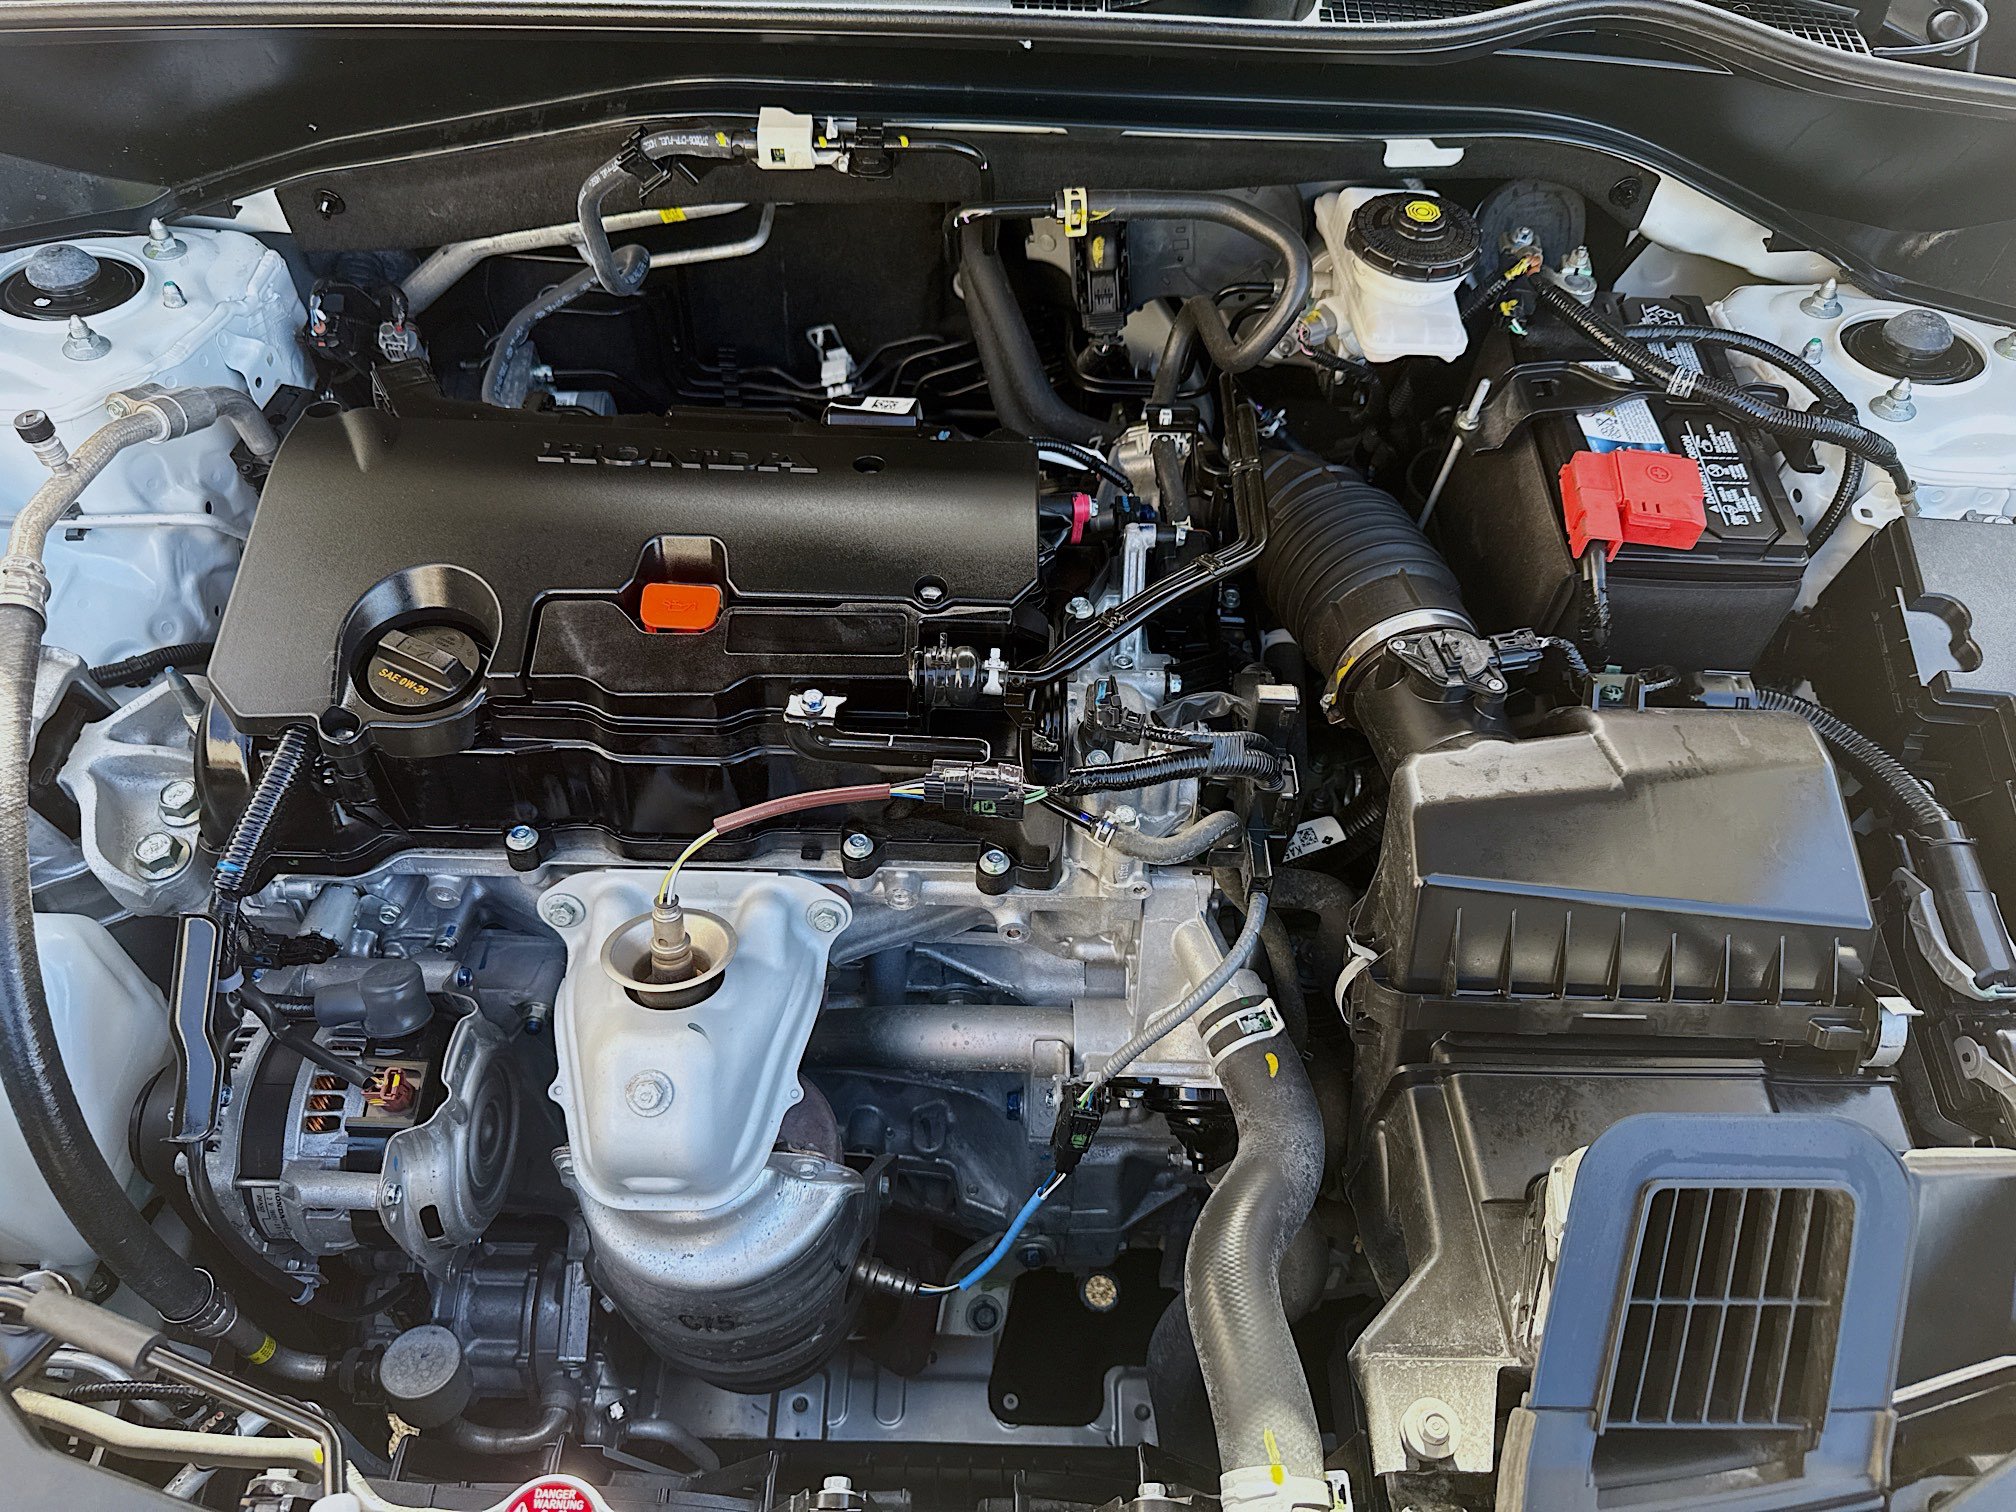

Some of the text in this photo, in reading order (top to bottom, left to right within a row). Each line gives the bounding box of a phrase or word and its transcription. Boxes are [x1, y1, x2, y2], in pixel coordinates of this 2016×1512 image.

[536, 441, 819, 473] HONDA
[378, 668, 430, 696] SAE 0W-20
[534, 1488, 577, 1500] DANGER
[533, 1498, 584, 1511] WARNUNG
